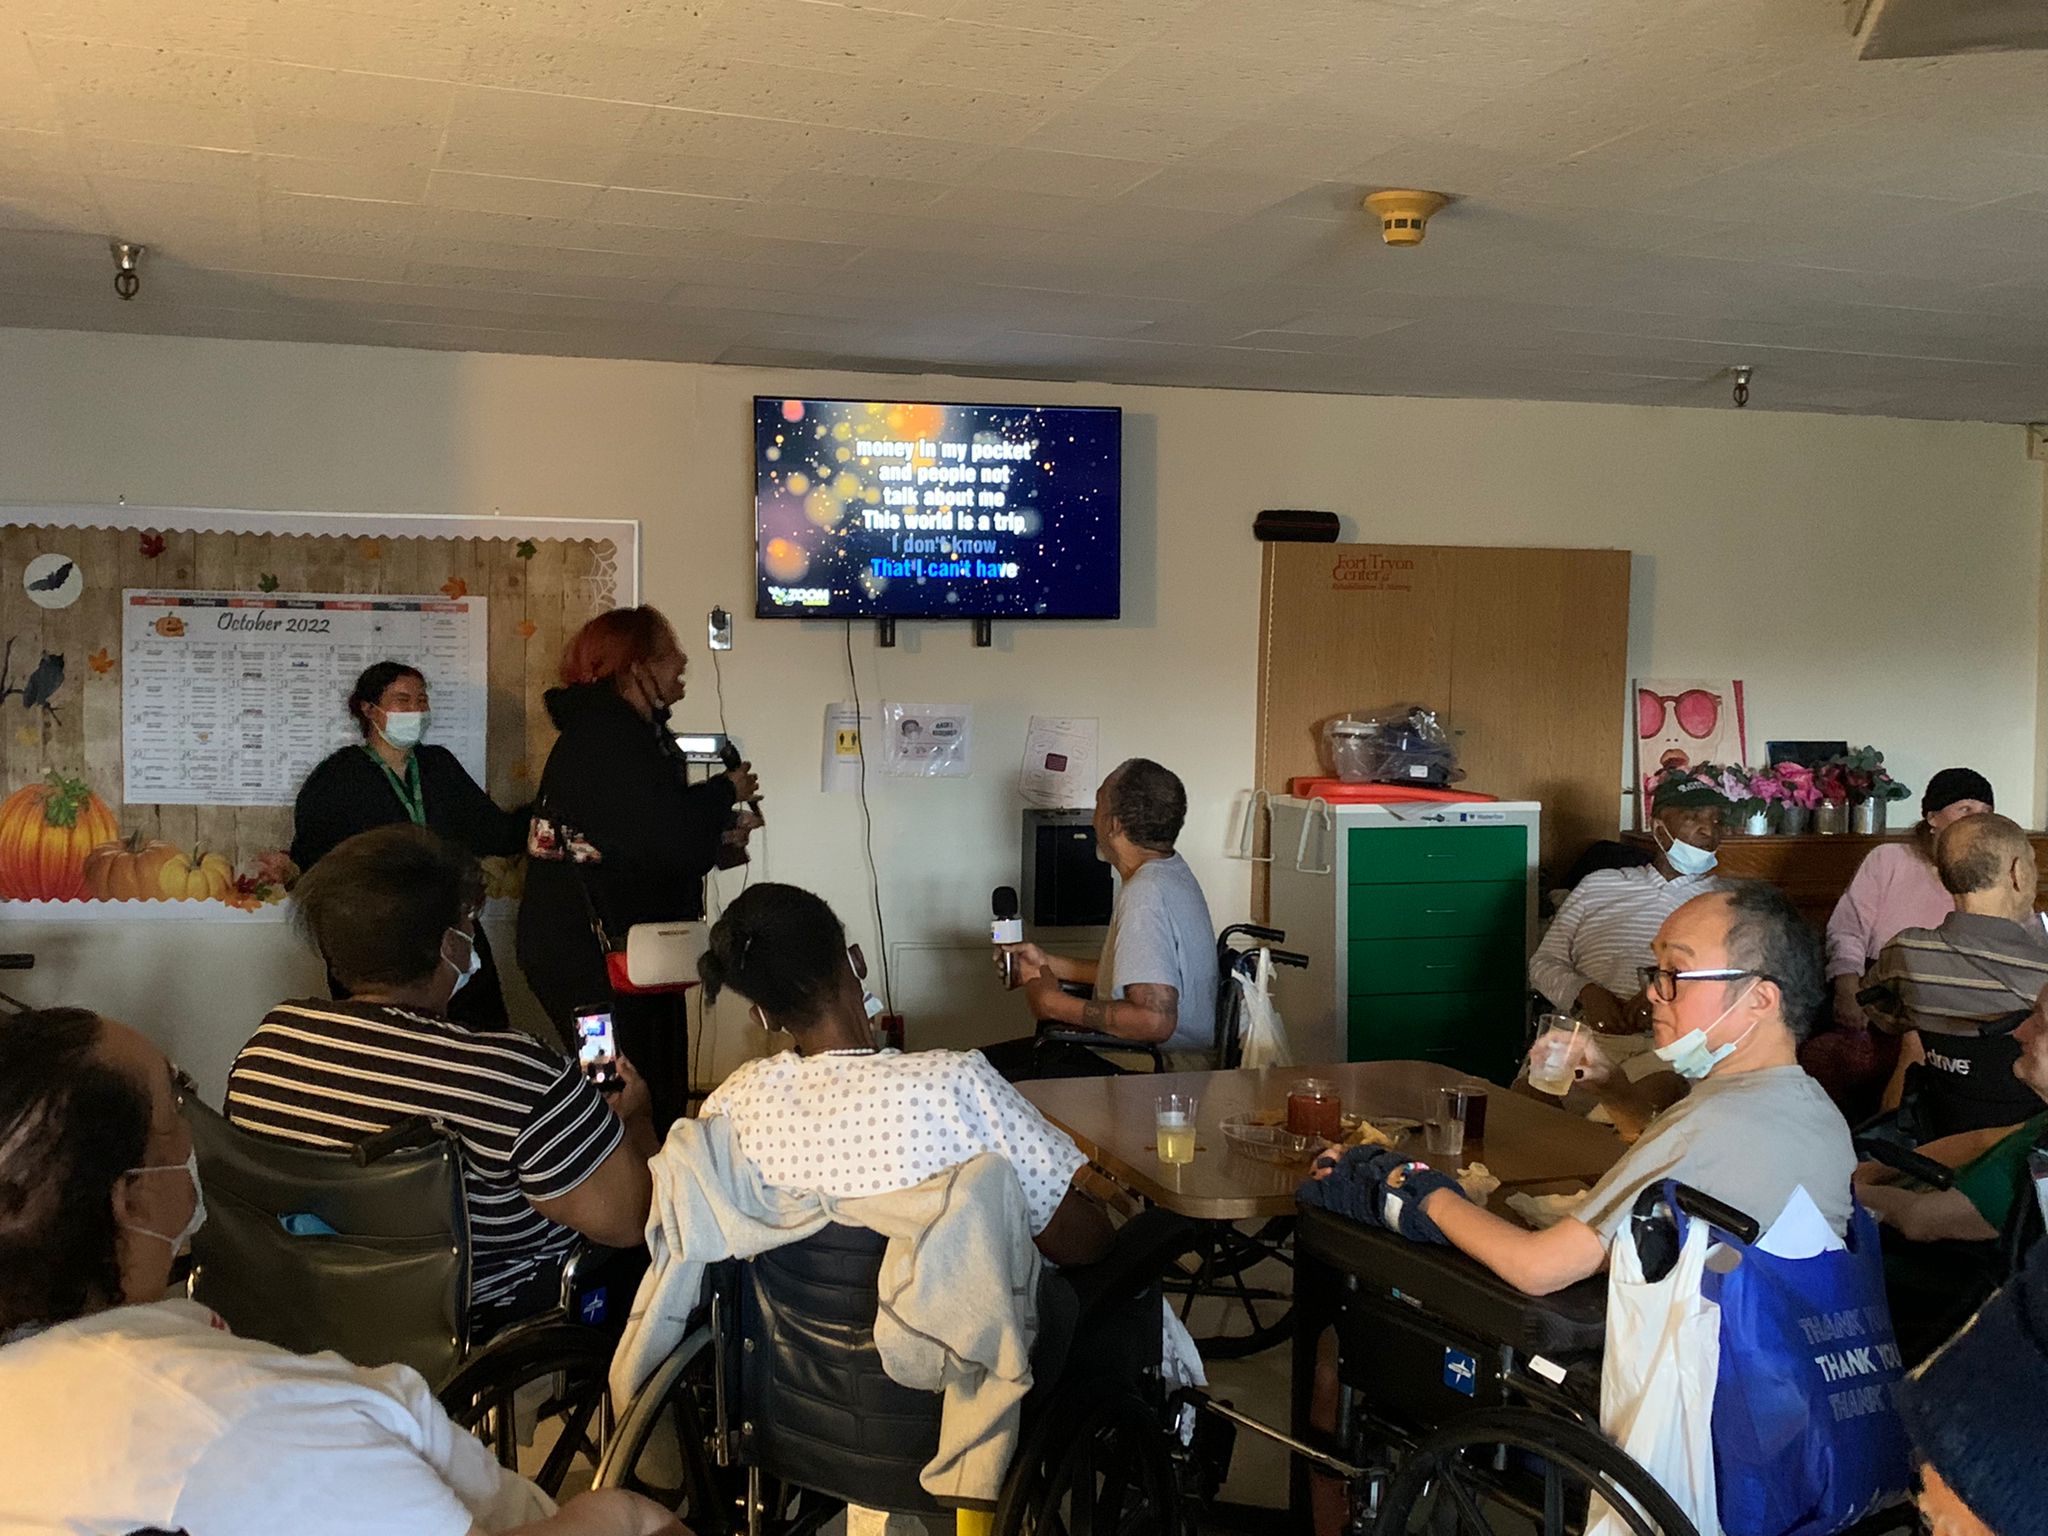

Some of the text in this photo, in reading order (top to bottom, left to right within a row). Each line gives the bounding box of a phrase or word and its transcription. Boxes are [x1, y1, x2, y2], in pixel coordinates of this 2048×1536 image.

[856, 438, 1031, 462] money in my pocket
[879, 463, 1010, 485] and people not
[883, 487, 1005, 507] talk about me
[862, 509, 900, 530] This
[904, 511, 953, 530] world
[957, 511, 975, 531] is
[978, 515, 990, 531] a
[892, 536, 997, 554] I don't know
[871, 558, 1018, 578] That I can't have
[1338, 554, 1368, 569] Fort
[1333, 565, 1382, 581] Center
[217, 610, 331, 634] October 2022
[1799, 1308, 1866, 1345] THANK
[1814, 1343, 1902, 1383] THANK YOU
[1828, 1384, 1885, 1423] THANK
